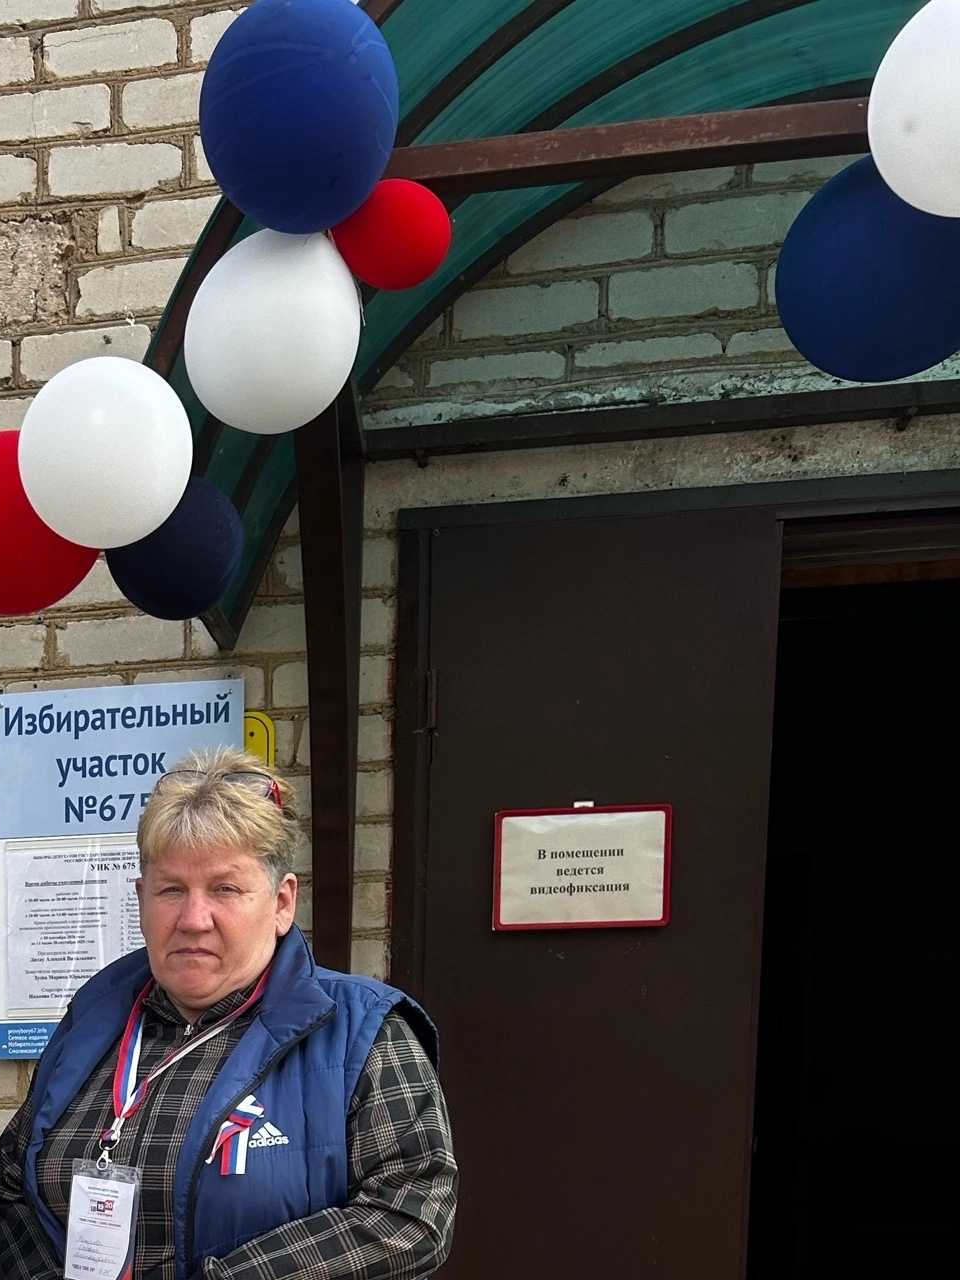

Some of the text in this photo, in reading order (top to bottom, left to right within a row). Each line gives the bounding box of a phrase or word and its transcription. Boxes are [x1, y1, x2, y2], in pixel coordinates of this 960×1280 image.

[3, 693, 231, 739] Избирательный
[56, 751, 166, 788] участок
[537, 848, 625, 860] В помещении
[90, 862, 136, 872] УИК № 675
[556, 866, 604, 877] ведется
[530, 882, 630, 896] видеофиксация
[248, 1135, 290, 1148] adidas
[105, 1201, 113, 1209] 20
